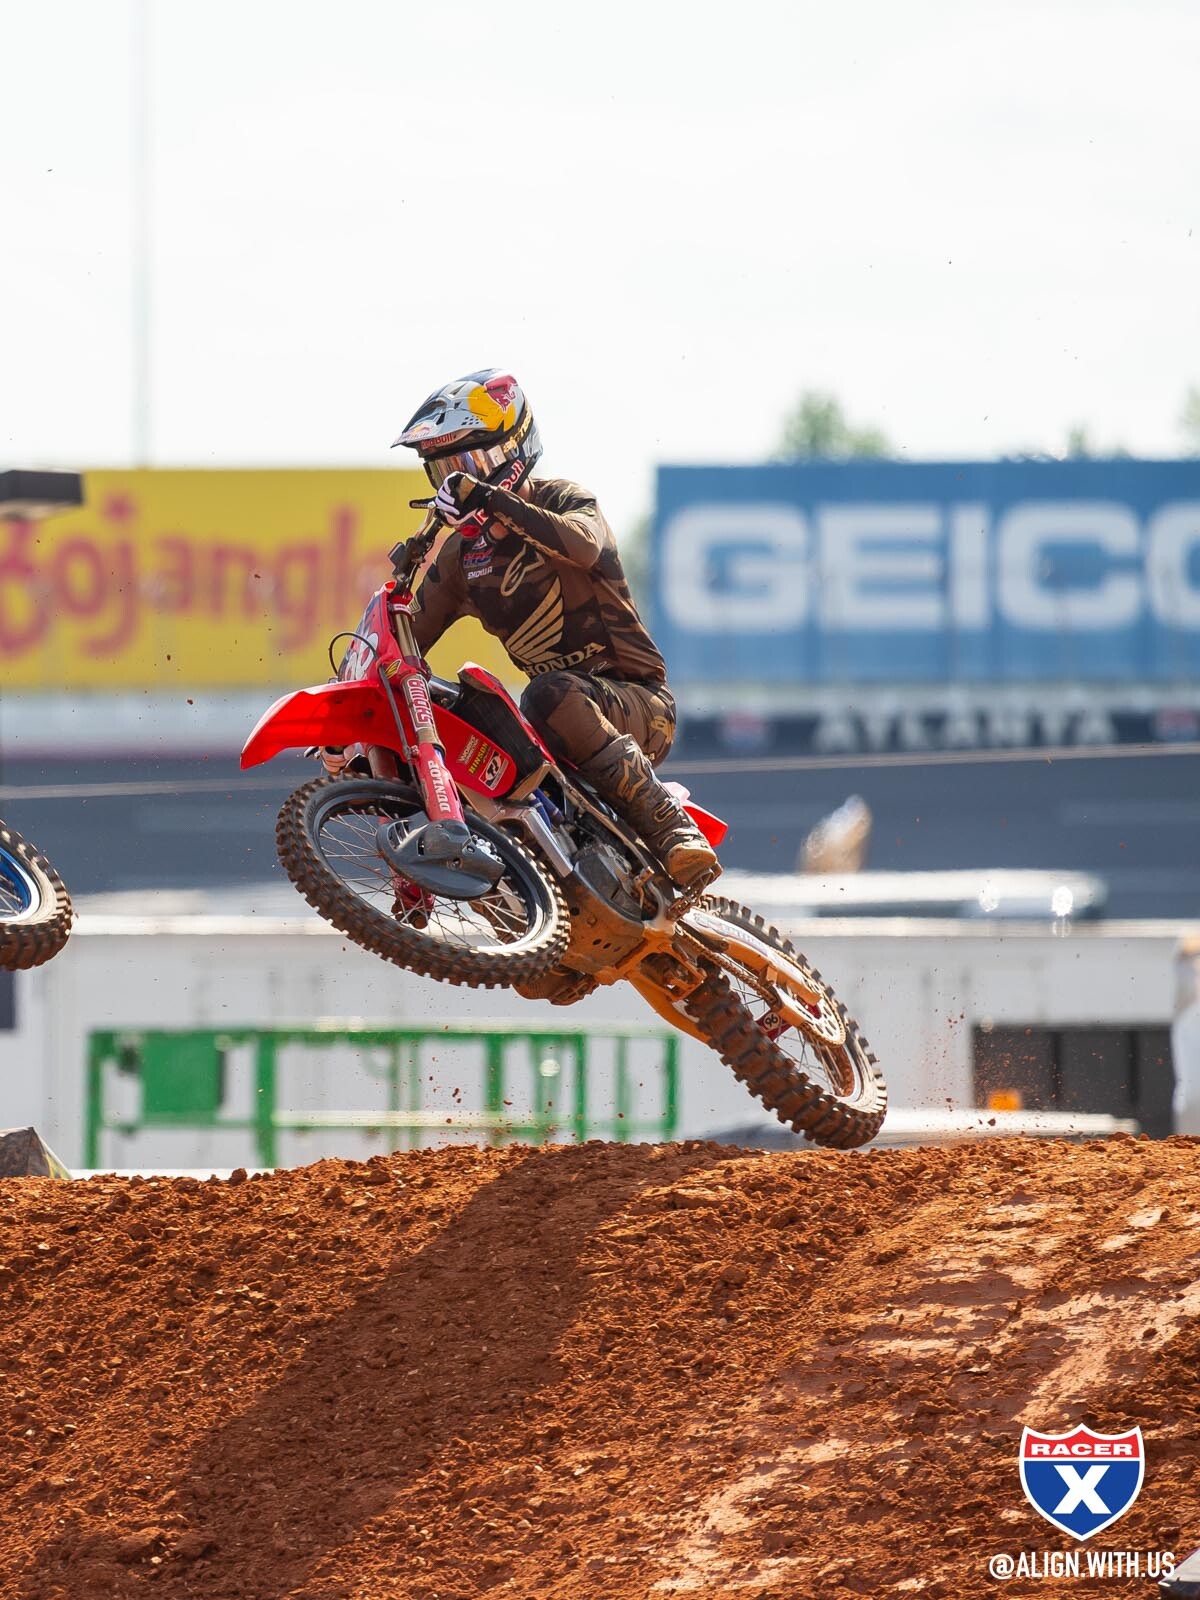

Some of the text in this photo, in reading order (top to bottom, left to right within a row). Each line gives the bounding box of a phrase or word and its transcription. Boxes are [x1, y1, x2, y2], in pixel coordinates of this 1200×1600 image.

[522, 642, 606, 677] HONDA
[409, 678, 432, 728] SHOWA
[812, 694, 1116, 752] ATLANTA
[468, 742, 489, 774] HINSON
[428, 760, 450, 812] DUNLOP
